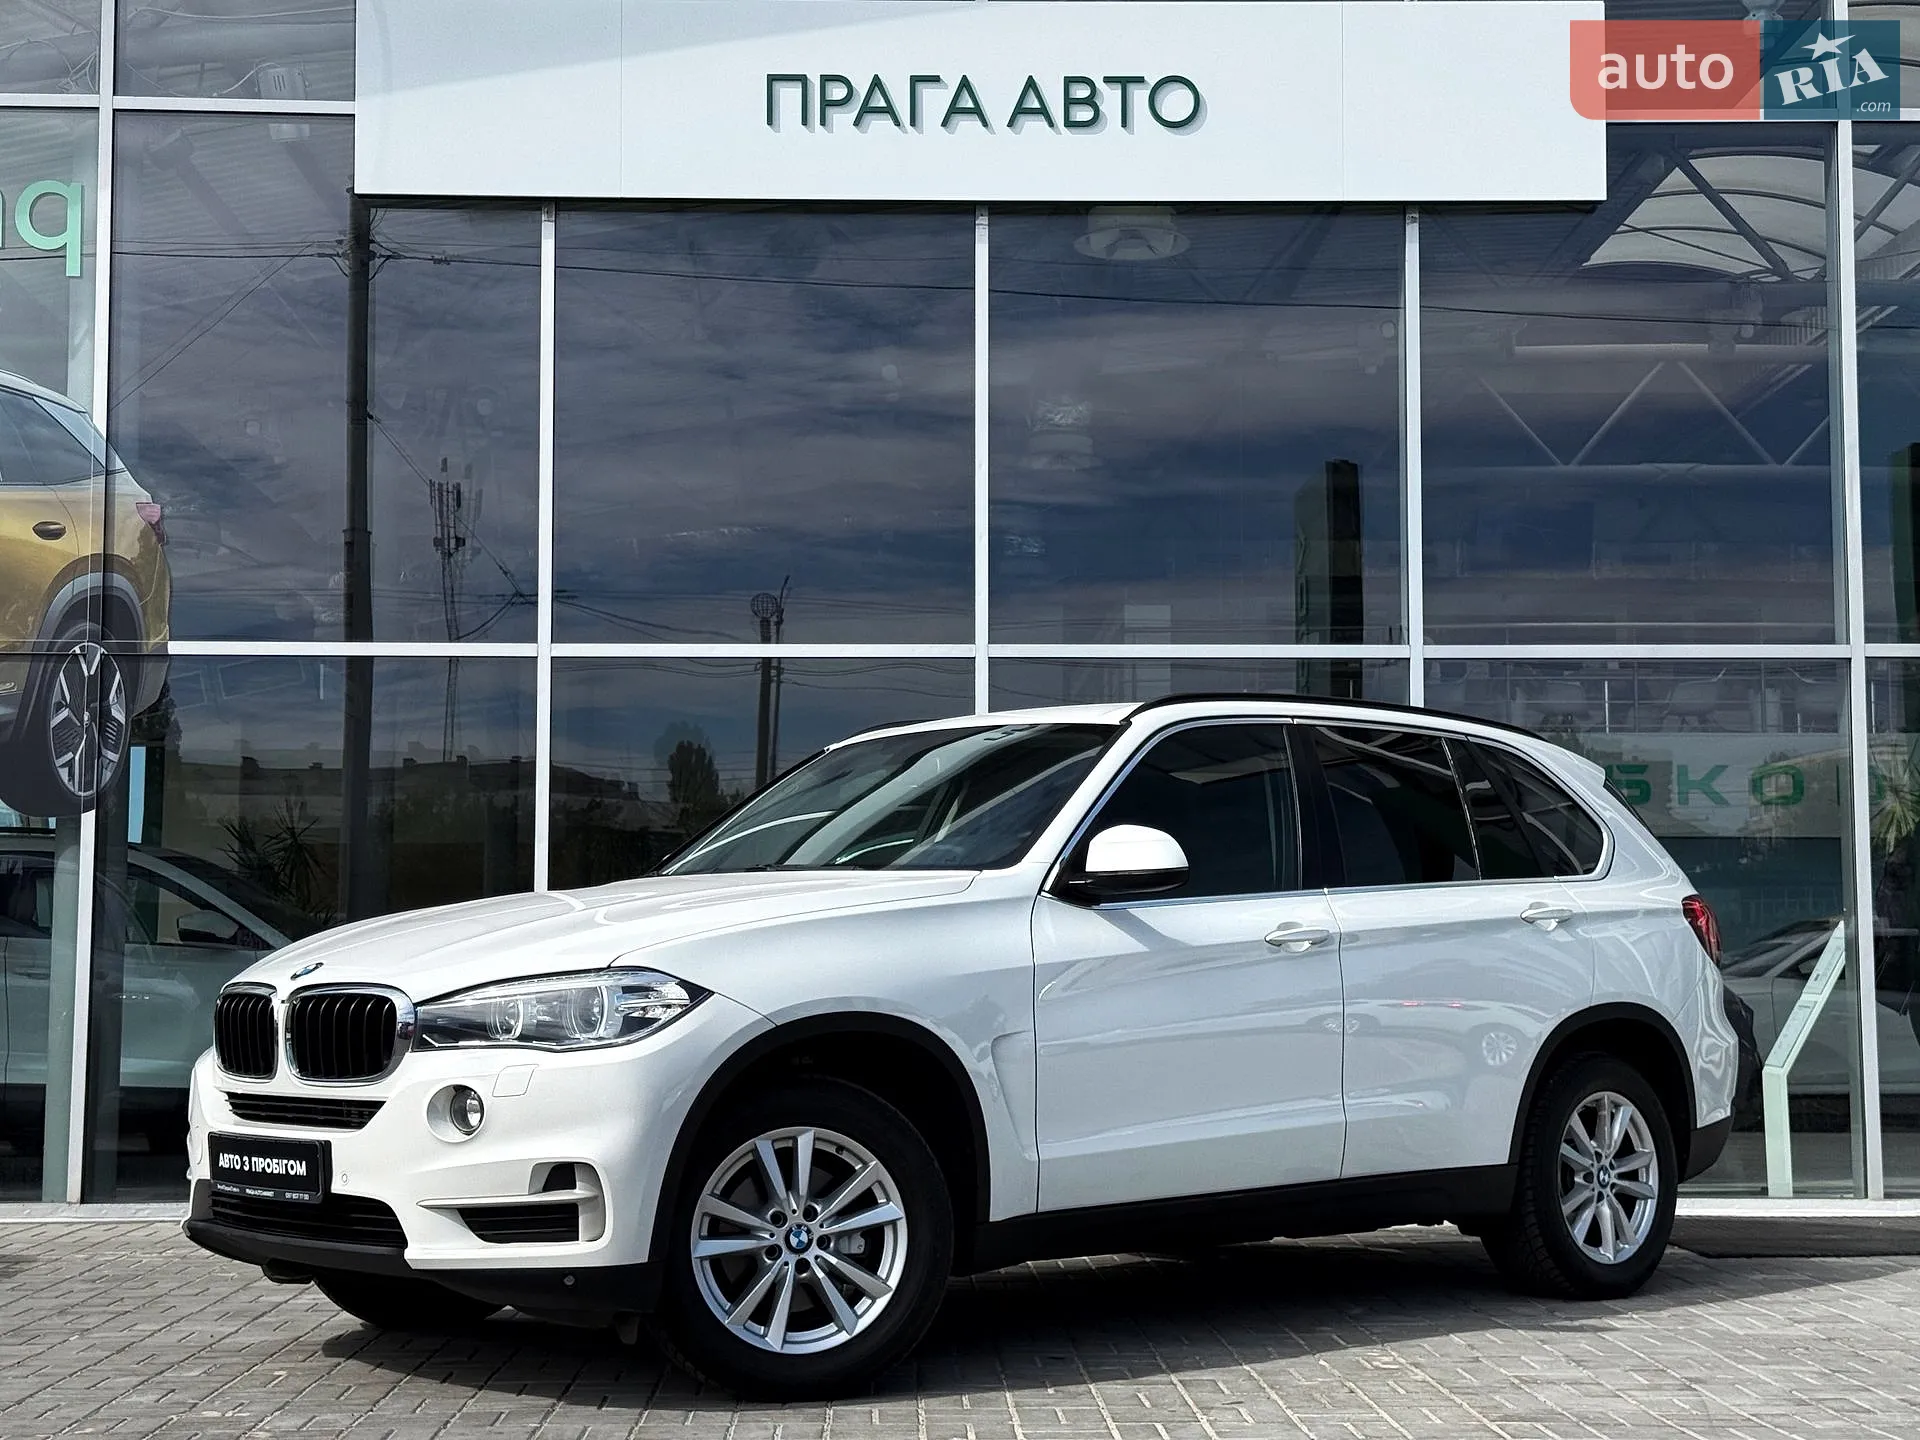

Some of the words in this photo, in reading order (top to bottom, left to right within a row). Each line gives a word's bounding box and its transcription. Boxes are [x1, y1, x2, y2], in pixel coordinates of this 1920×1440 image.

[766, 74, 989, 128] ПРАГА
[1006, 75, 1201, 129] АВТО
[219, 1152, 241, 1170] АВТО
[243, 1155, 250, 1171] З
[251, 1156, 307, 1176] ПРОБІГОМ
